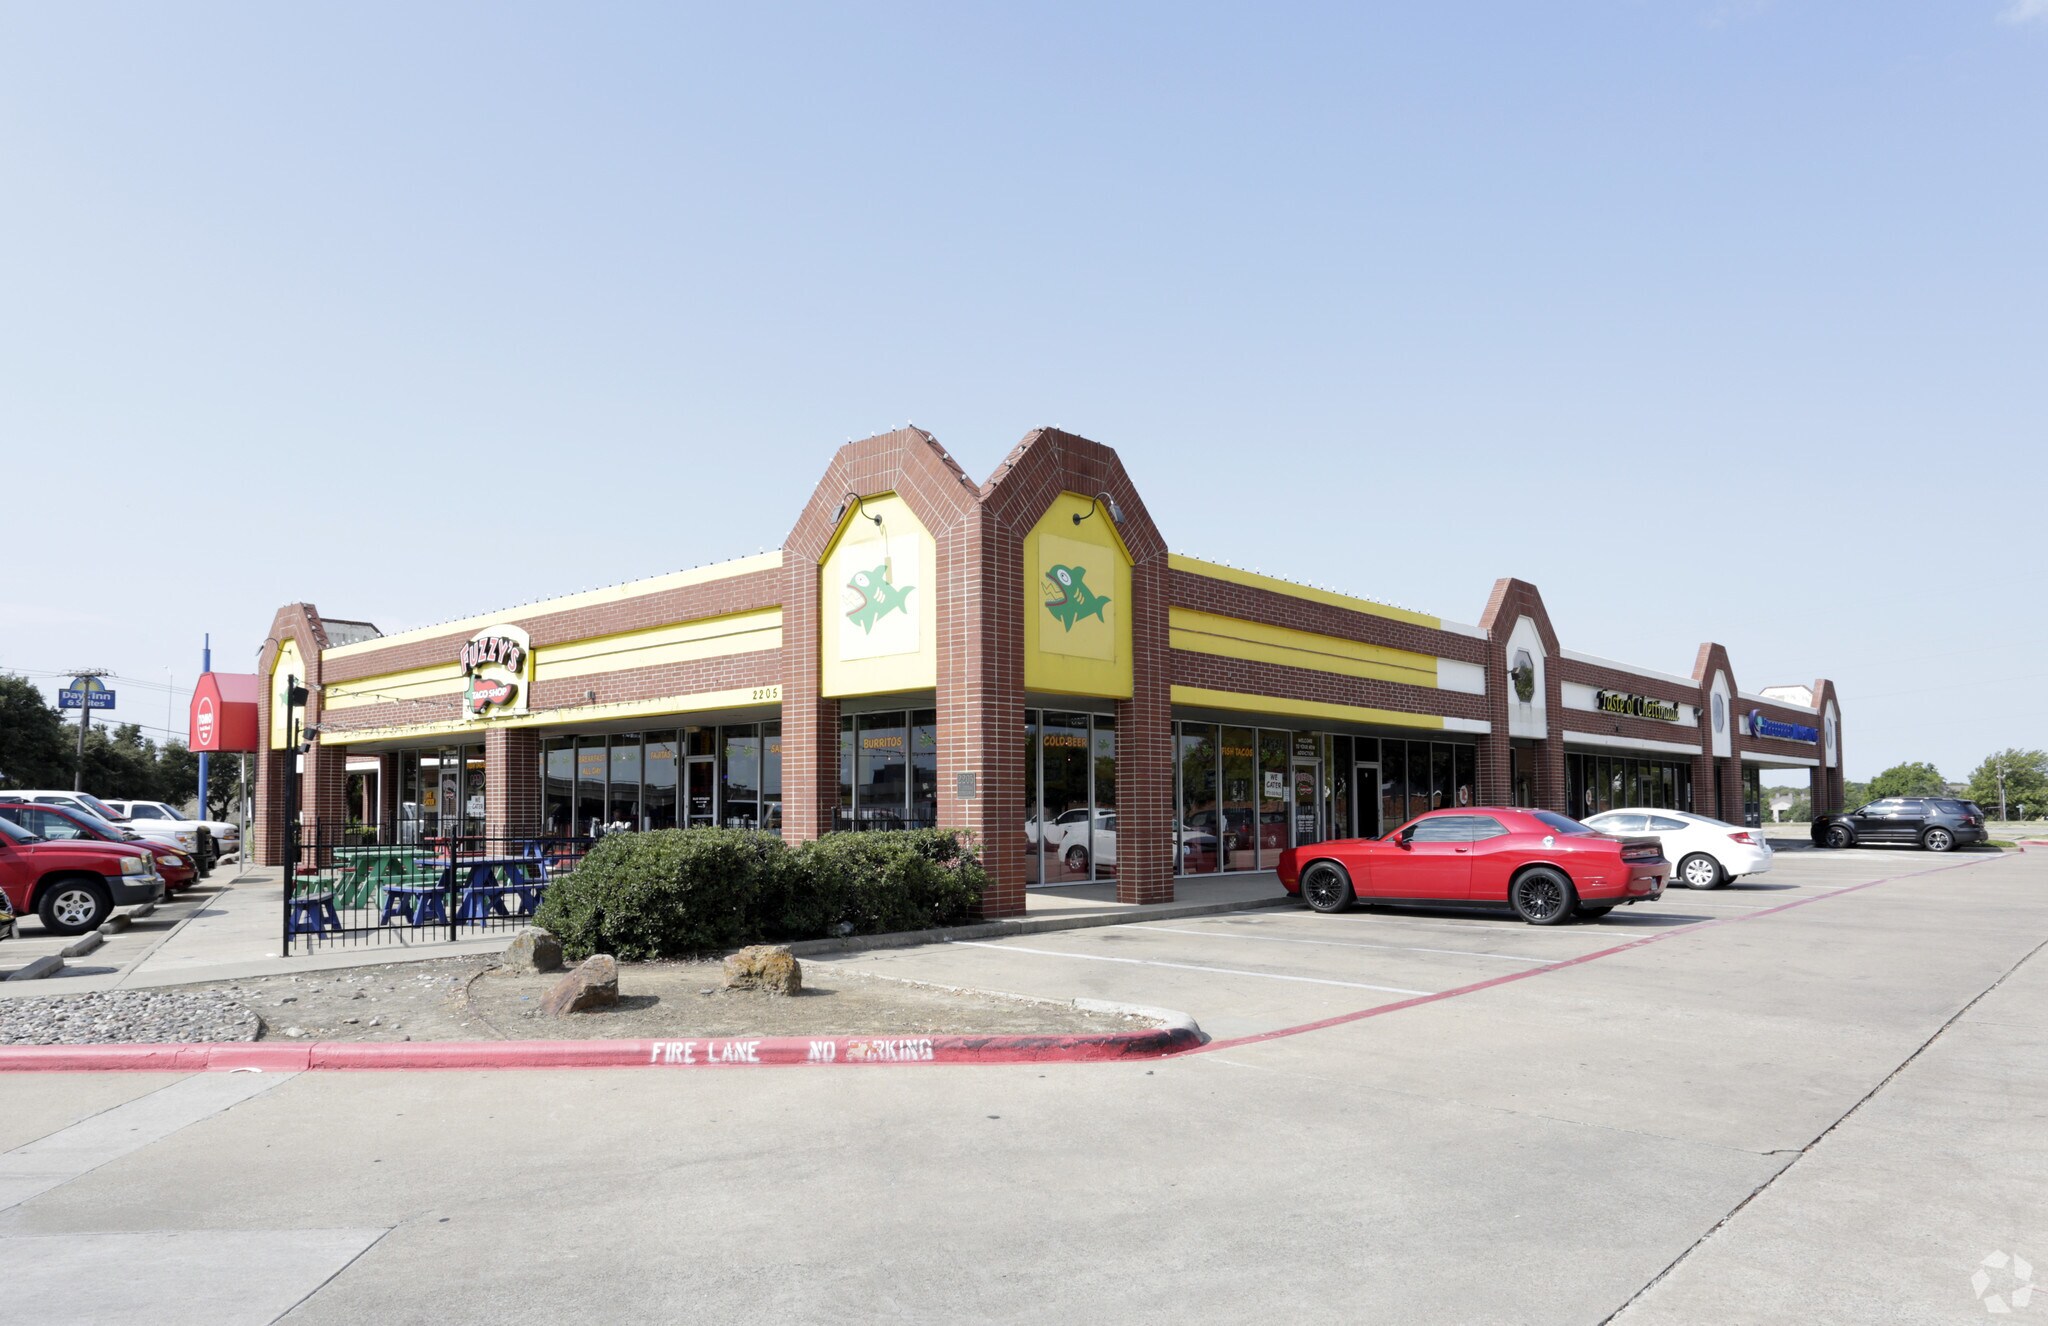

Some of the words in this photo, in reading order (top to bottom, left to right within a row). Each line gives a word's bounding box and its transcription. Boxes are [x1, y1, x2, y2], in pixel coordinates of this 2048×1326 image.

[460, 637, 520, 675] FUZZY'S
[62, 691, 91, 701] Day
[91, 692, 111, 700] Inn
[472, 689, 488, 699] TACO
[489, 687, 507, 697] SHOP
[753, 688, 778, 700] 2205
[1599, 690, 1625, 713] Taste
[863, 736, 902, 749] BURRITOS
[1043, 736, 1065, 747] COLD
[1066, 736, 1087, 747] BEER
[650, 750, 672, 760] FAJITAS
[1222, 747, 1234, 756] FISH
[1235, 747, 1253, 757] TACOS
[1266, 781, 1282, 789] CATER
[651, 1042, 698, 1063] FIRE
[707, 1041, 761, 1063] LANE
[807, 1041, 836, 1062] NO
